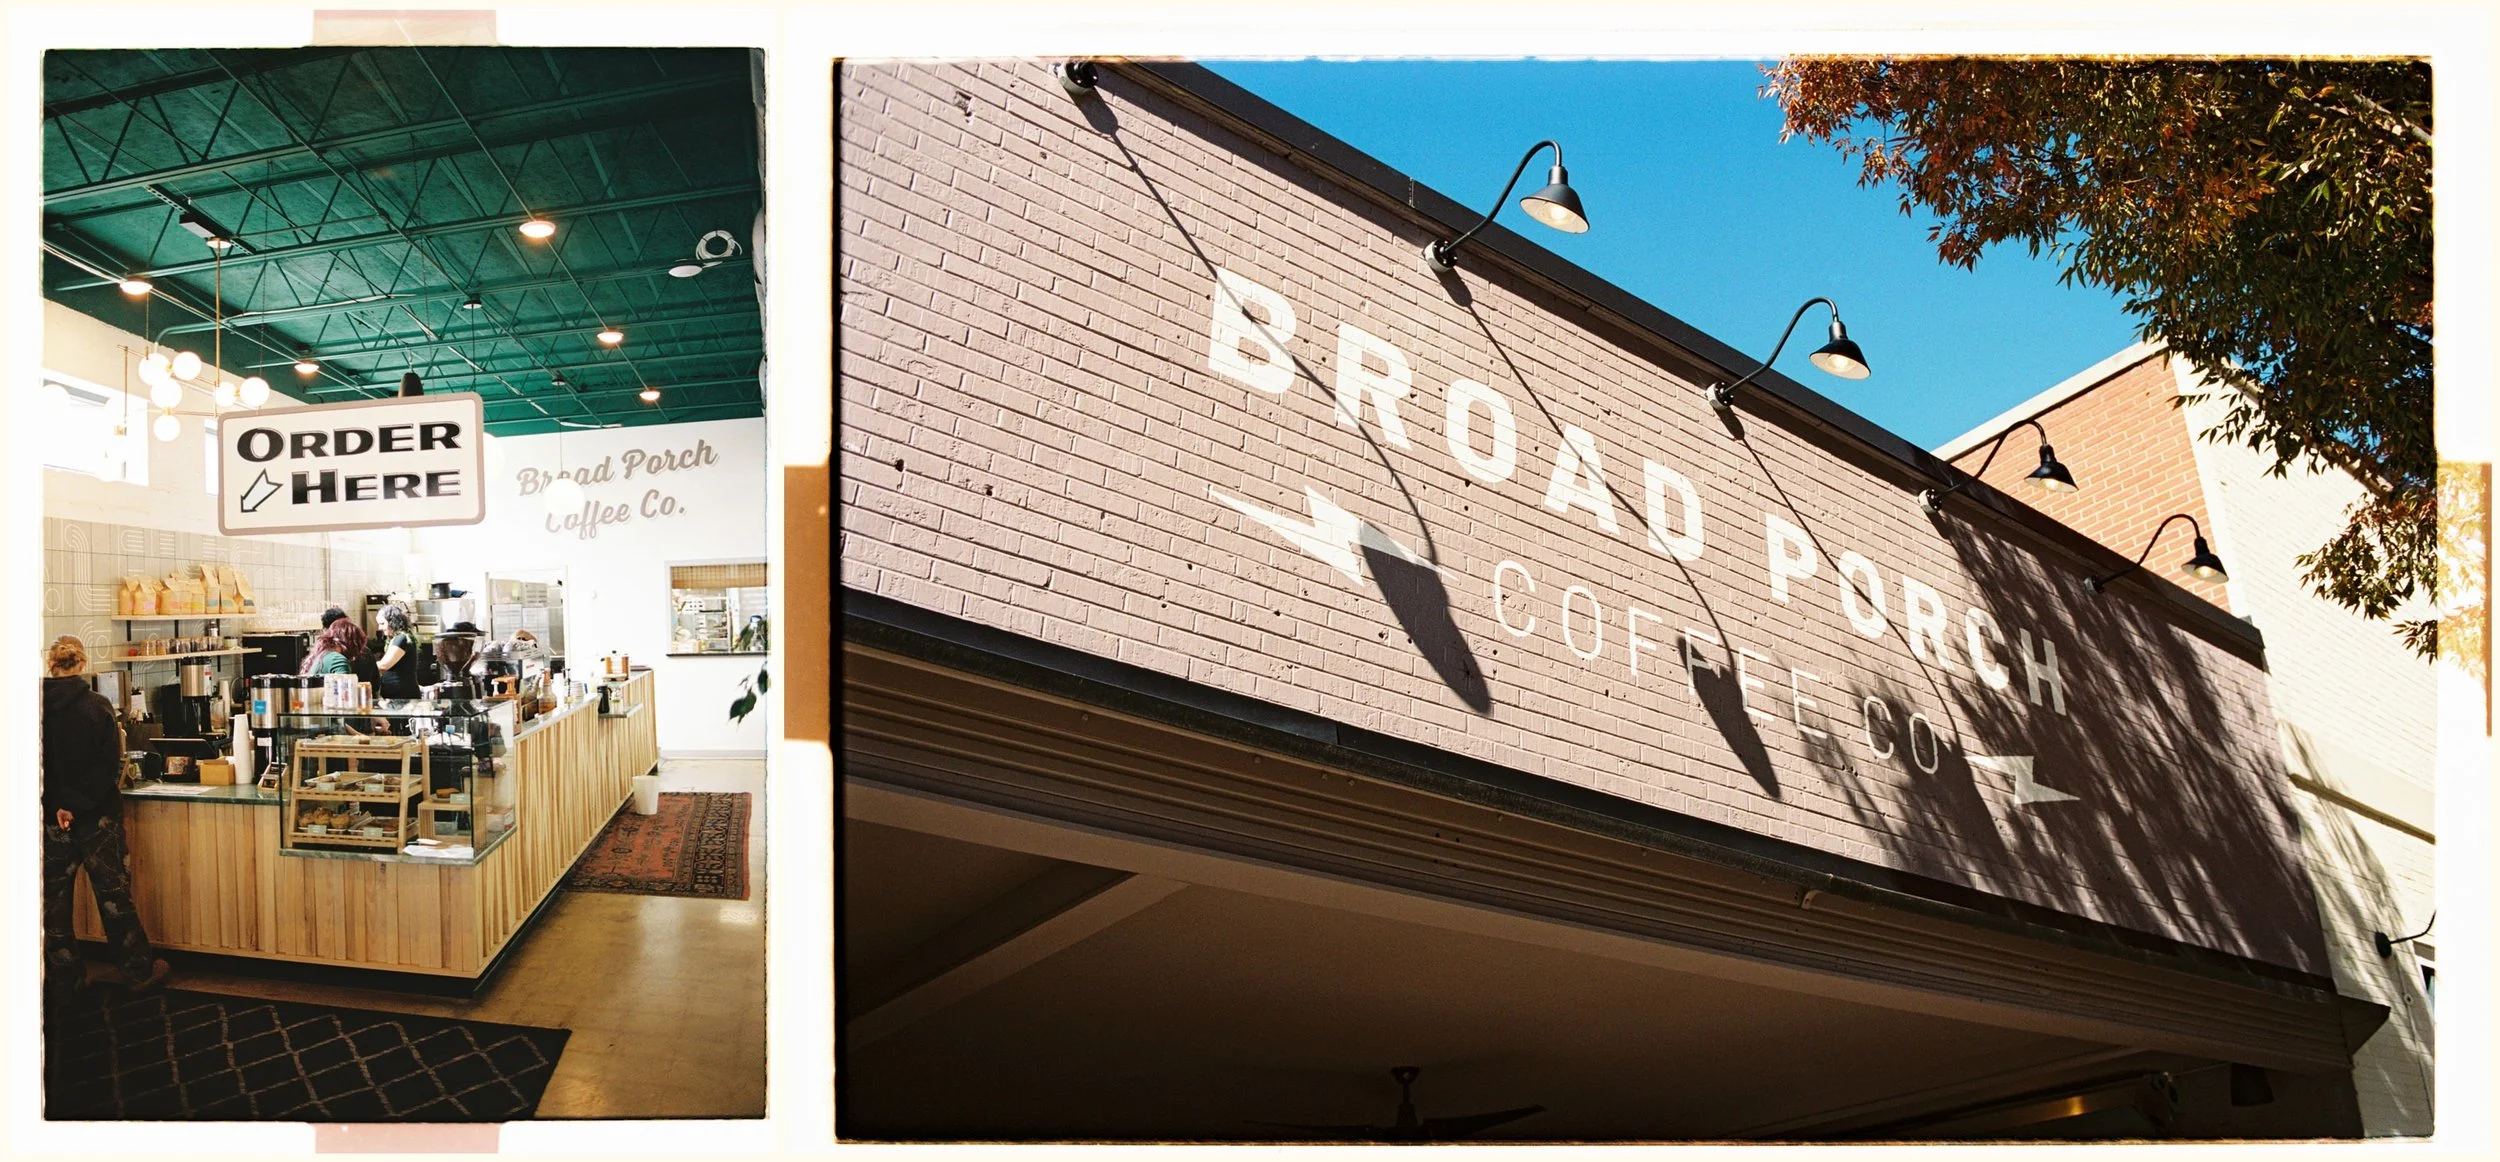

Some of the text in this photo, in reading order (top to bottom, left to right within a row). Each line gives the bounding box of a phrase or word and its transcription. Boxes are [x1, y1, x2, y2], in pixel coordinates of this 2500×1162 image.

[237, 420, 462, 463] ORDER
[621, 438, 718, 480] Porch
[291, 468, 461, 505] HERE
[640, 488, 685, 519] Co.
[1207, 266, 2067, 716] BROAD PORCH
[1493, 559, 1939, 775] COFFEE CO
